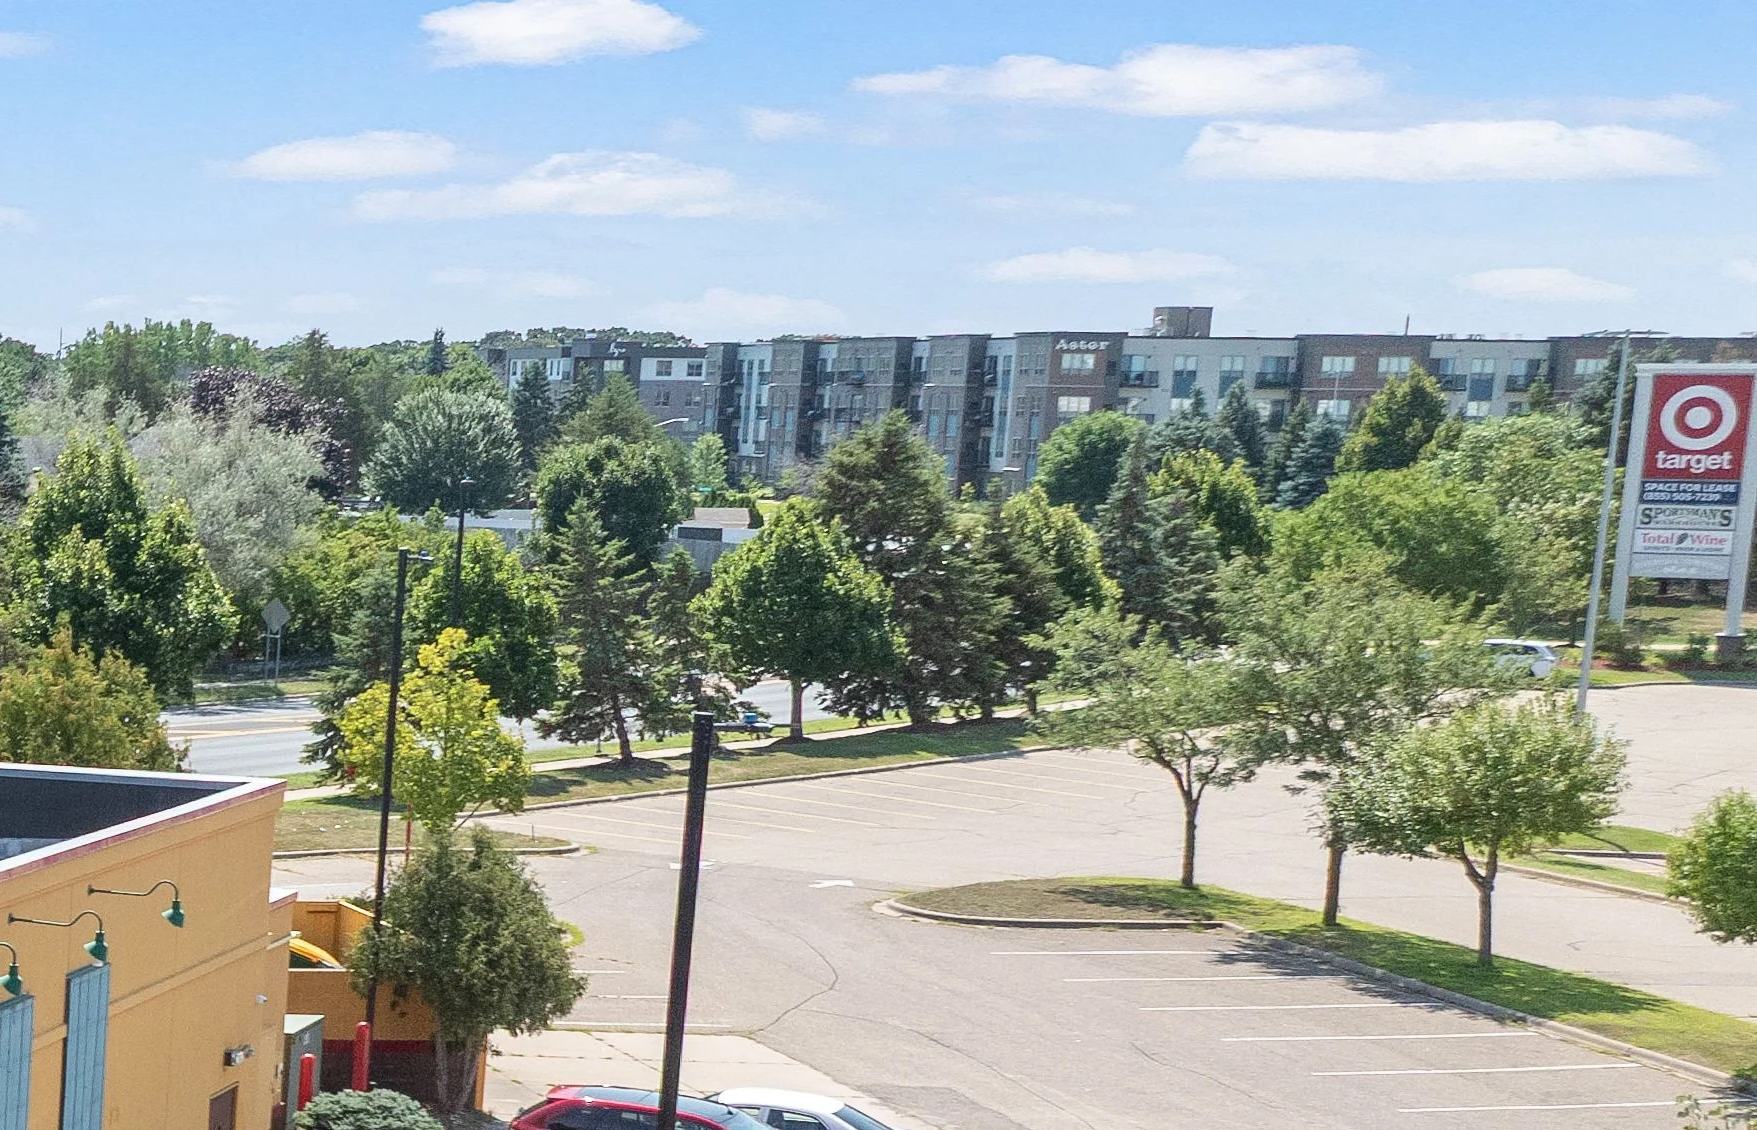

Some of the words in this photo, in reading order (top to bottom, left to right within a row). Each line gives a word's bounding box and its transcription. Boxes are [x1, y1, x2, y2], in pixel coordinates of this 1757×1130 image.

[1655, 450, 1733, 473] target
[1644, 483, 1678, 491] SPACE
[1679, 483, 1701, 492] FOR
[1702, 484, 1737, 493] LEASE
[1642, 532, 1674, 544] Total
[1690, 534, 1728, 545] Wine
